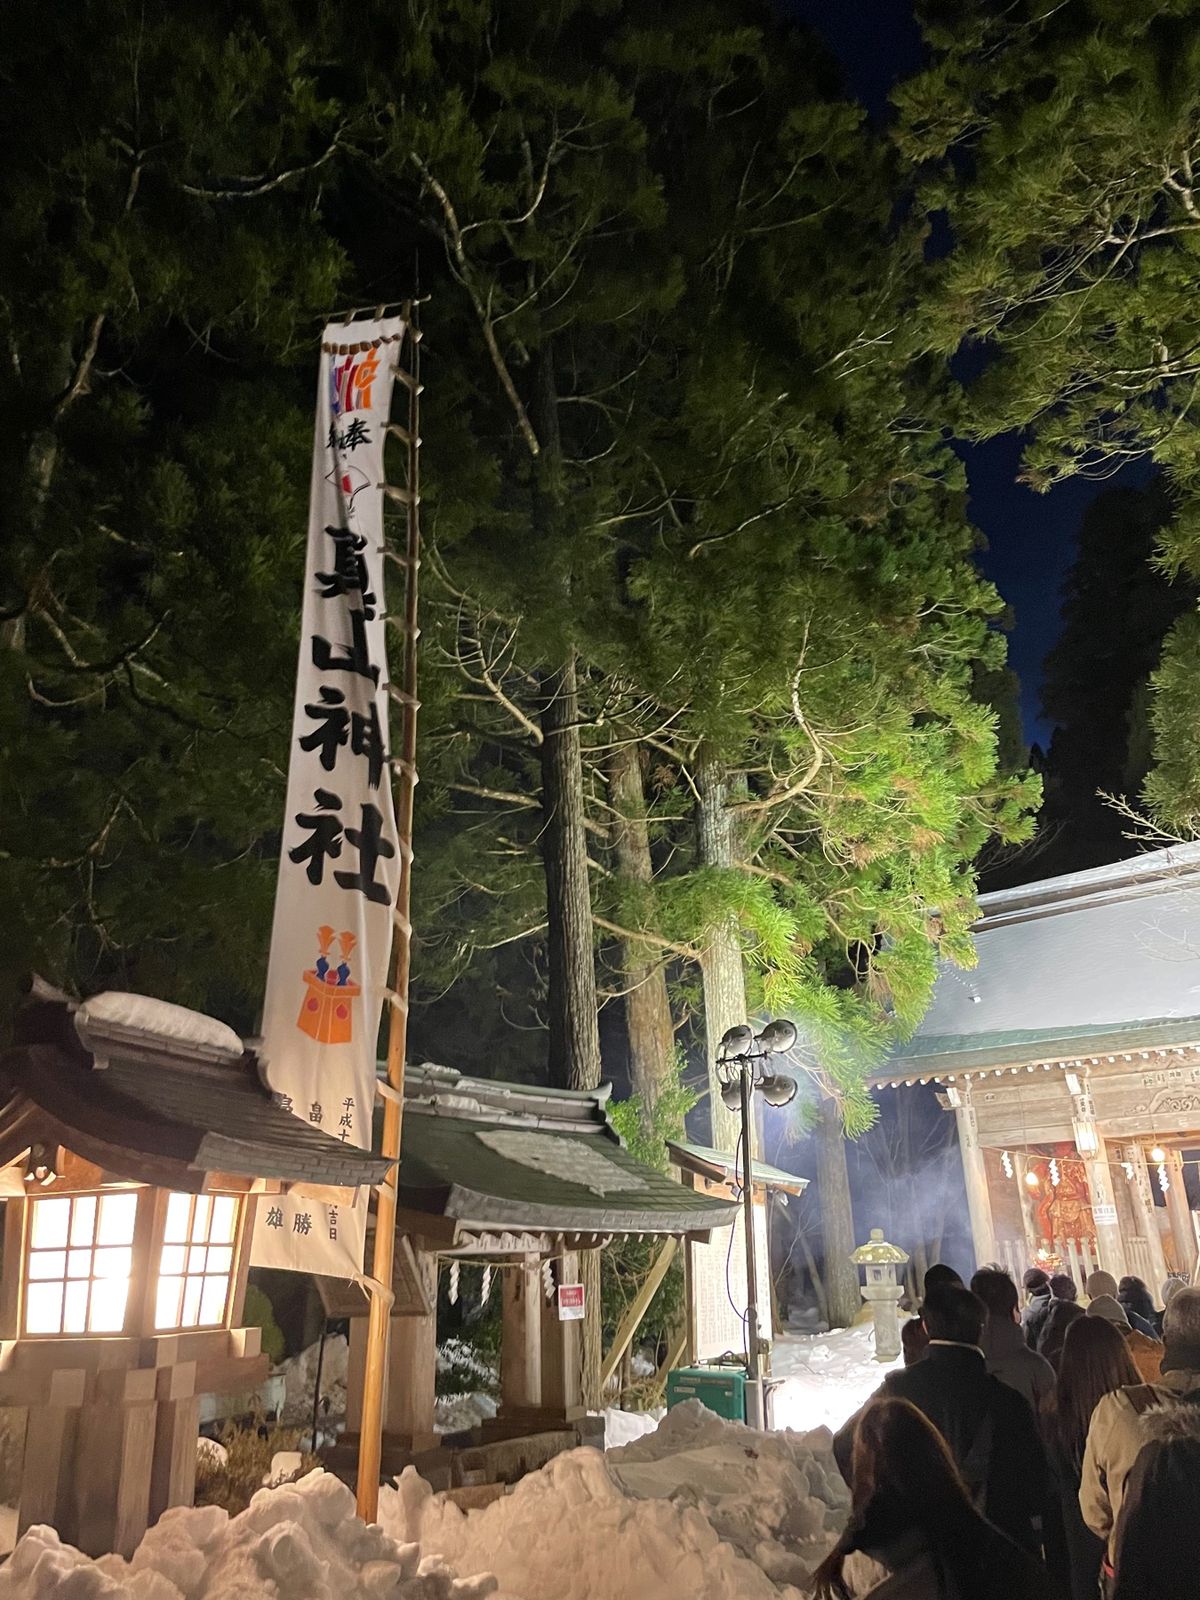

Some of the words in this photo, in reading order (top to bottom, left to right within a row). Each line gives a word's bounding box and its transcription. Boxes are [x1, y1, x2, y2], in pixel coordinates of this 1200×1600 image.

[265, 1206, 283, 1229] 雄
[292, 1212, 312, 1236] 勝
[328, 1204, 338, 1240] 吉日
